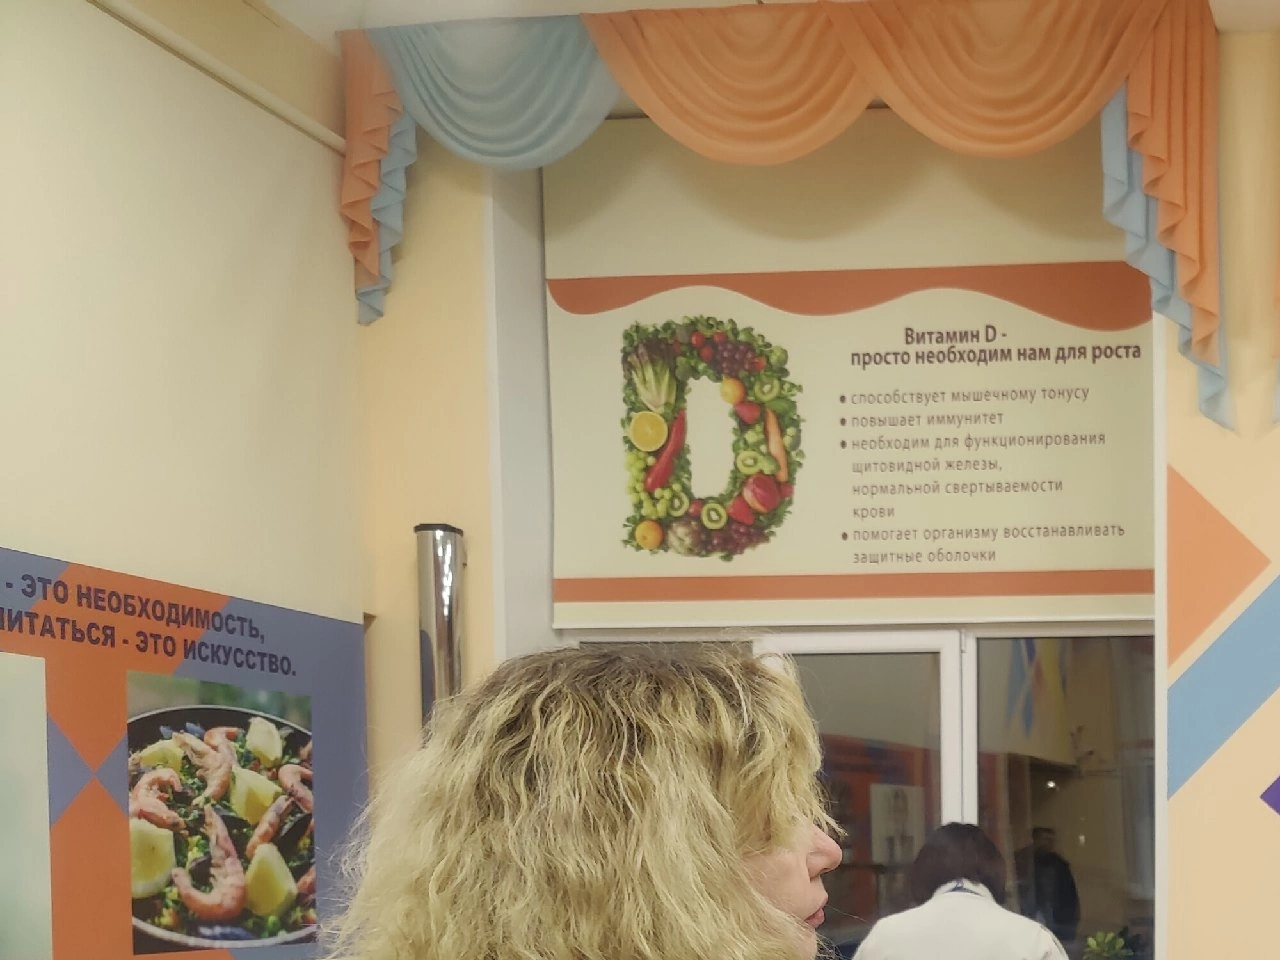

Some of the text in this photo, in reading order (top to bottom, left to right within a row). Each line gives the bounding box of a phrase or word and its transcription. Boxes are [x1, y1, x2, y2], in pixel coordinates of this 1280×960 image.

[904, 327, 980, 345] Витамин
[985, 325, 997, 343] D
[851, 344, 1142, 370] просто необходим нам для роста
[851, 386, 1090, 406] способствует мышечному тонусу
[851, 411, 1004, 429] повышает иммунитет
[852, 431, 1107, 451] необходим для функционирования
[852, 457, 1003, 474] щитовидной железы,
[852, 479, 1064, 497] нормальной свертываемости
[852, 506, 895, 520] крови
[852, 523, 1126, 542] помогает организму восстанавливать
[853, 547, 996, 565] защитные оболочки
[21, 574, 69, 604] ЭТО
[76, 584, 265, 644] НЕОБХОДИМОСТЬ,
[135, 631, 177, 657] ЭТО
[183, 638, 297, 677] ИСКУССТВО.
